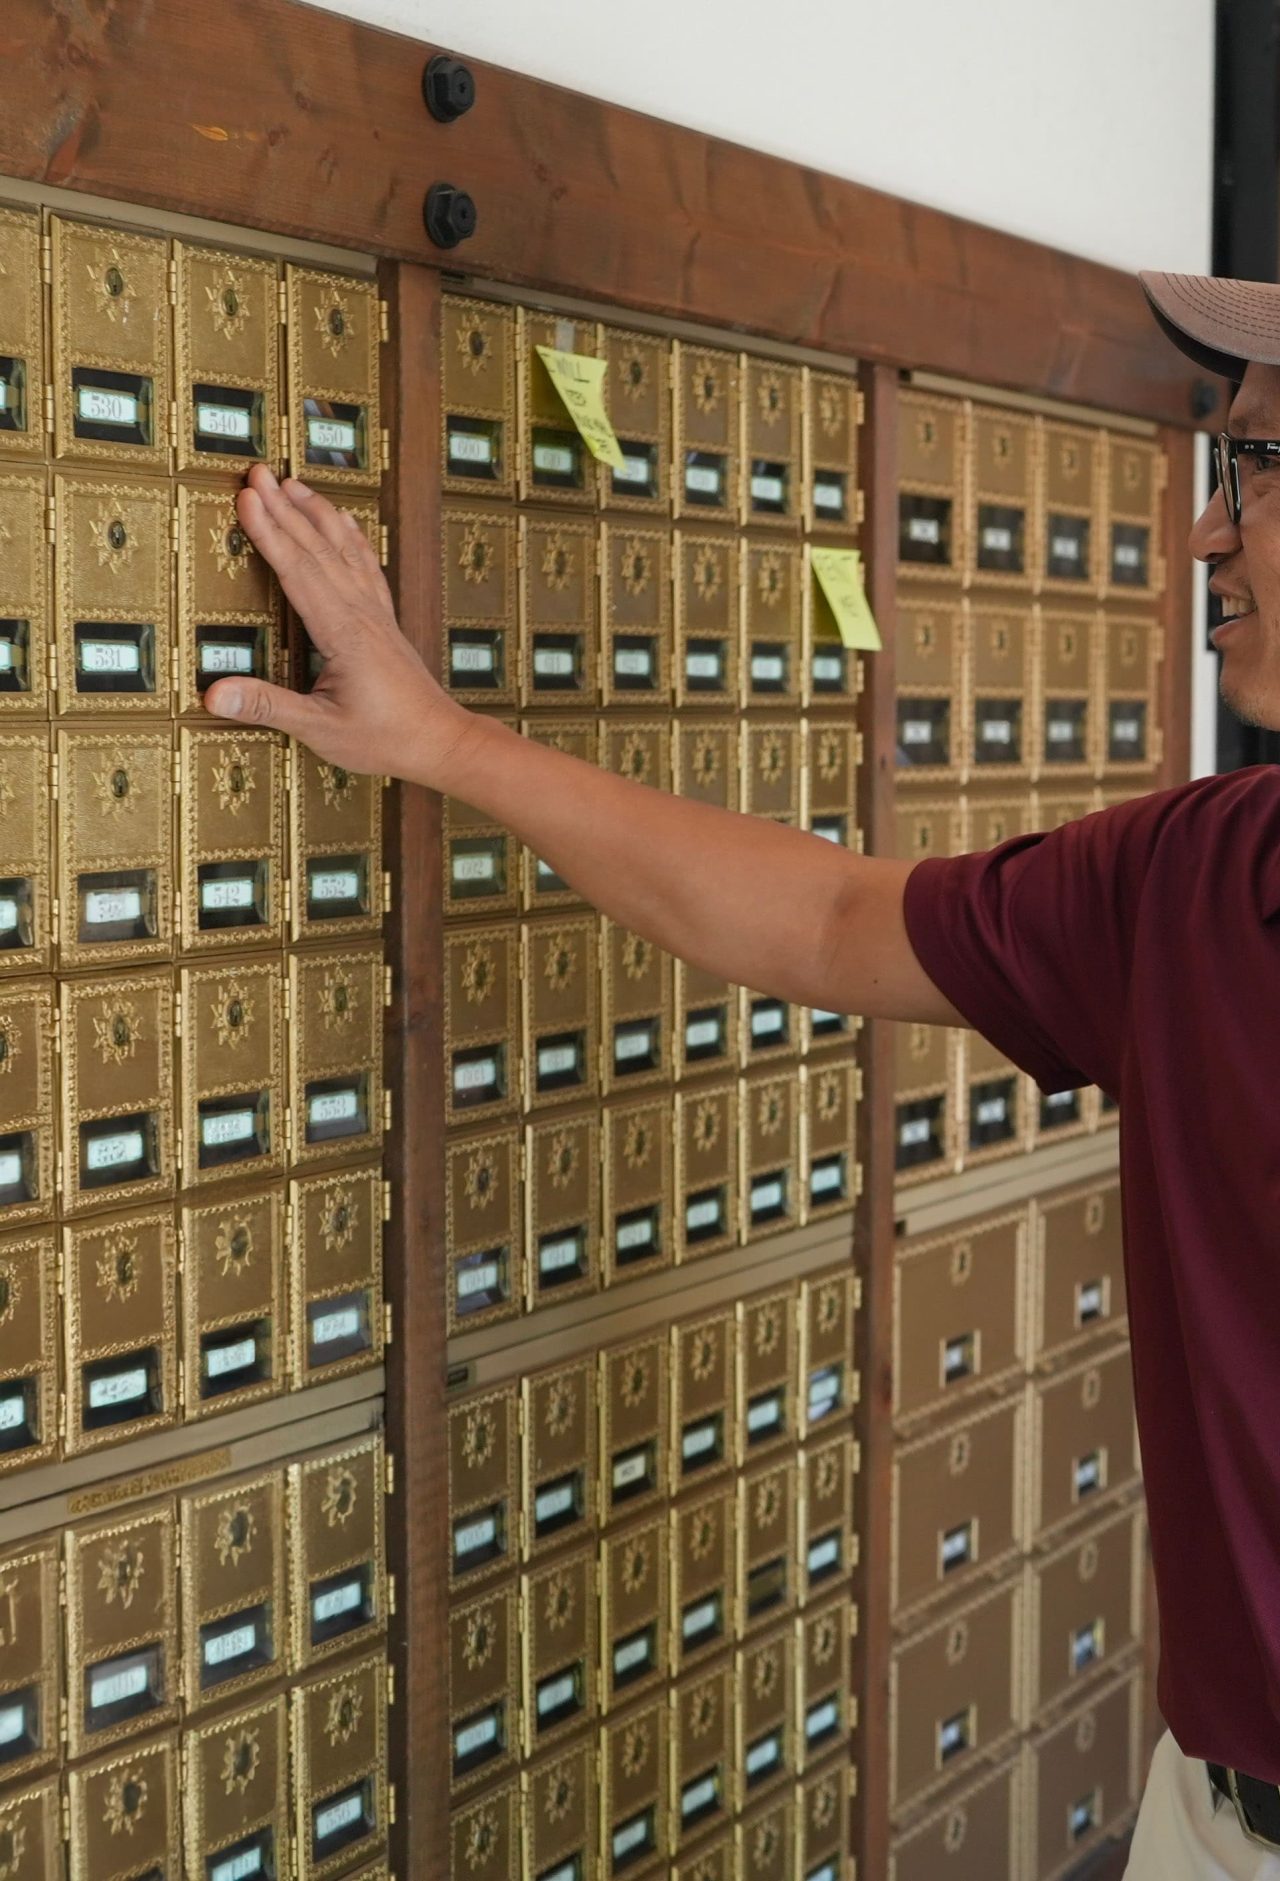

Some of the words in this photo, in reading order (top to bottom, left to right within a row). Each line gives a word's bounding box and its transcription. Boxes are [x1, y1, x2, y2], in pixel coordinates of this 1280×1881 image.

[90, 394, 122, 419] 530
[209, 411, 238, 434] 540
[317, 424, 343, 446] 550
[95, 647, 122, 668] 531
[212, 649, 239, 669] 541
[213, 886, 241, 907] 542
[321, 878, 346, 898] 552
